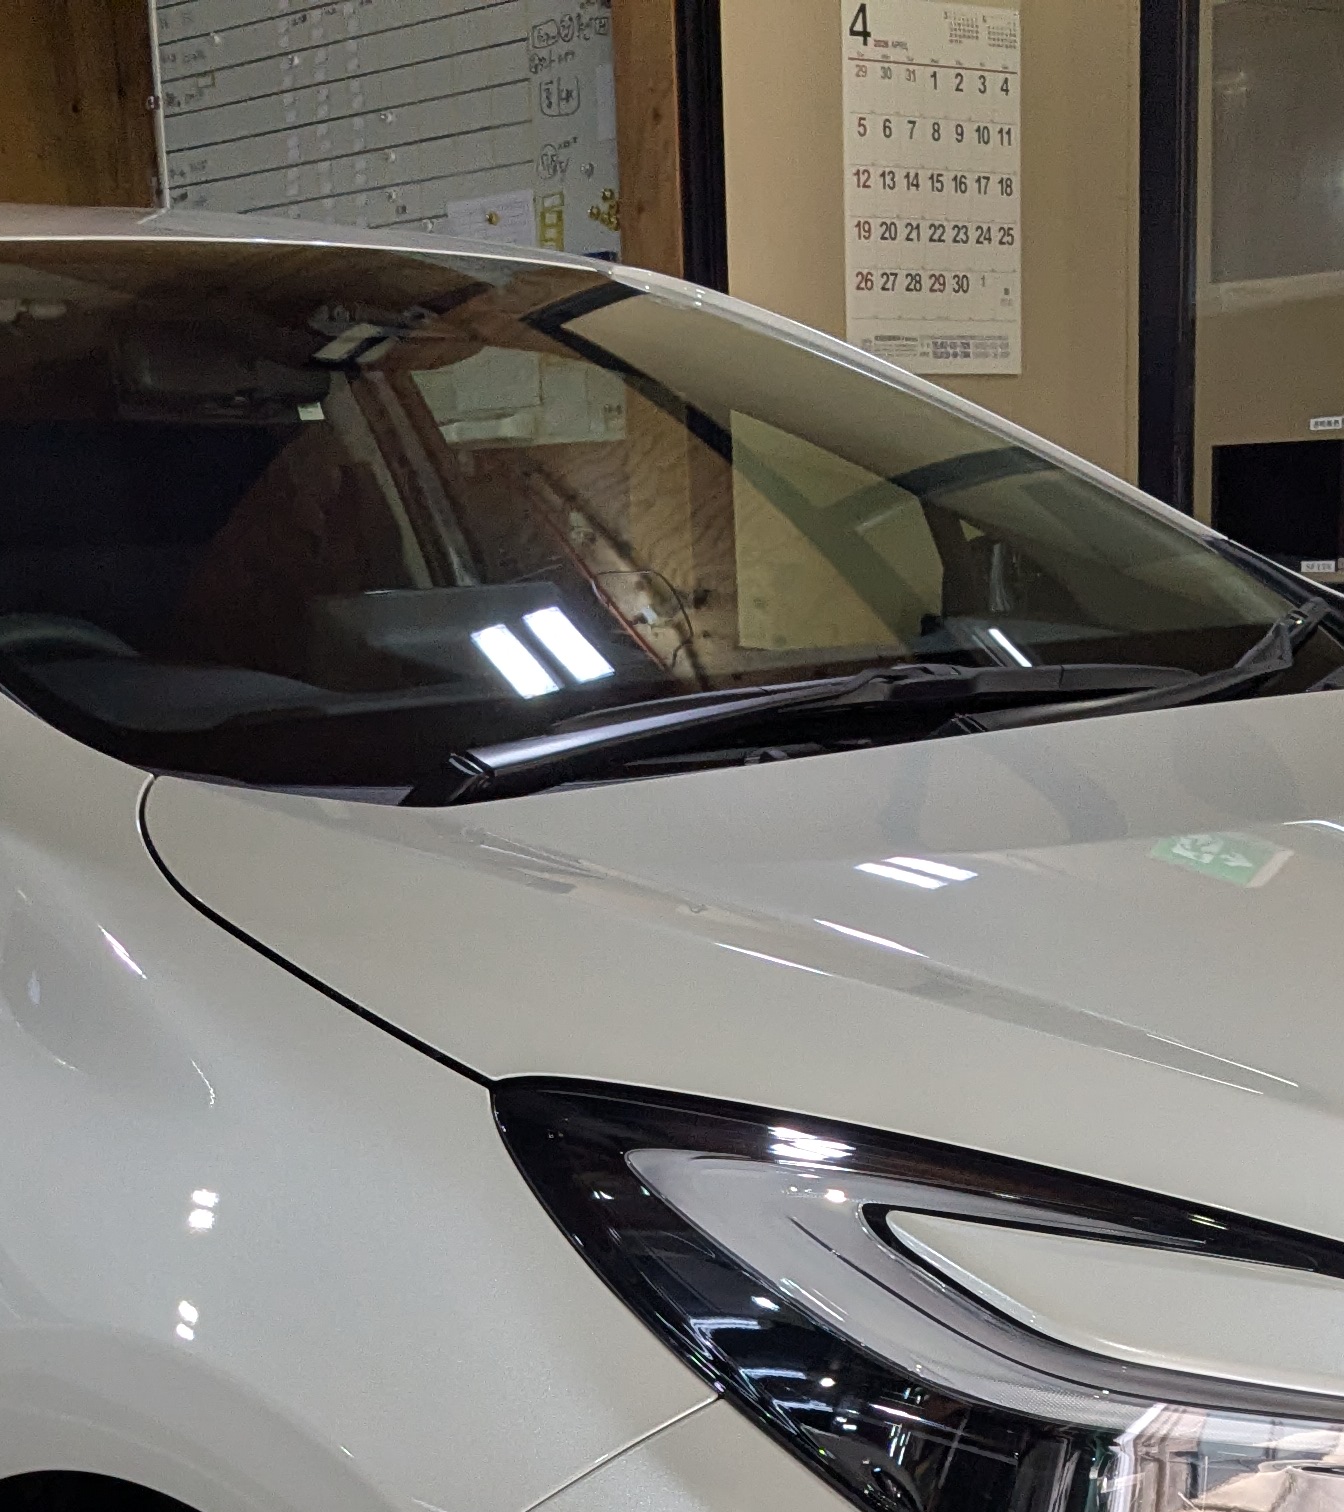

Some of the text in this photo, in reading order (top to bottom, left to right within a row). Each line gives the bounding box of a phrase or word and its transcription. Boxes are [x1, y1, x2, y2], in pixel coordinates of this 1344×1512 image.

[849, 3, 871, 46] 4
[856, 65, 1009, 95] 29 30 31 1 2 3 4
[858, 117, 1011, 146] 5 6 7 8 9 10 11
[854, 169, 1013, 196] 12 13 14 15 16 17 18
[855, 220, 1014, 245] 19 20 21 22 23 24 25
[856, 272, 873, 291] 26
[881, 273, 898, 291] 27
[906, 273, 922, 292] 28
[929, 274, 946, 293] 29
[953, 275, 969, 293] 30
